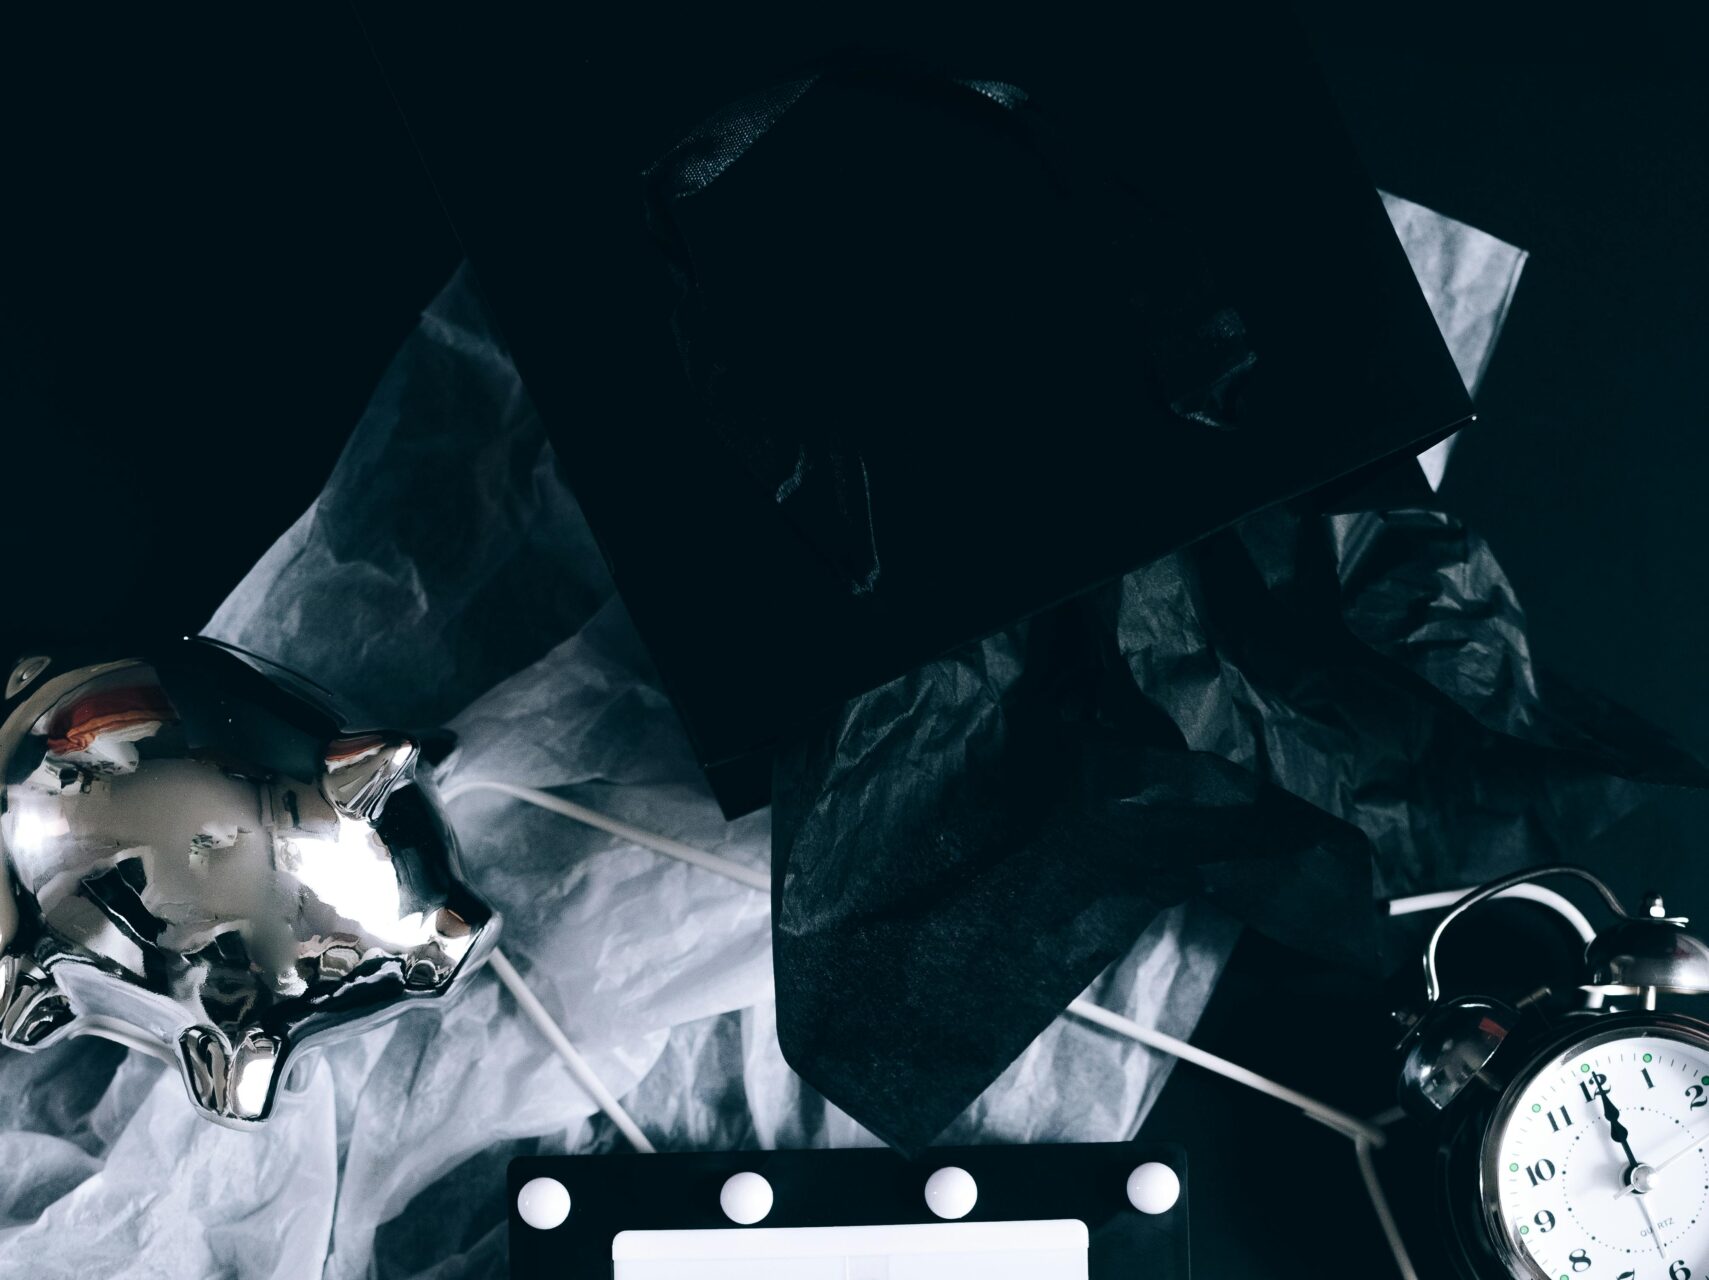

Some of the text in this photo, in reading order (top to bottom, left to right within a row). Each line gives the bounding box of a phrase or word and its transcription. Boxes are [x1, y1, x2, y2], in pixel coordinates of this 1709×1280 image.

[1579, 1073, 1612, 1103] 12
[1641, 1068, 1654, 1089] 1
[1685, 1085, 1708, 1111] 2
[1547, 1105, 1573, 1132] 11
[1526, 1158, 1556, 1187] 10
[1534, 1209, 1556, 1233] 9
[1640, 1217, 1675, 1238] QURTZ
[1568, 1248, 1592, 1273] 8
